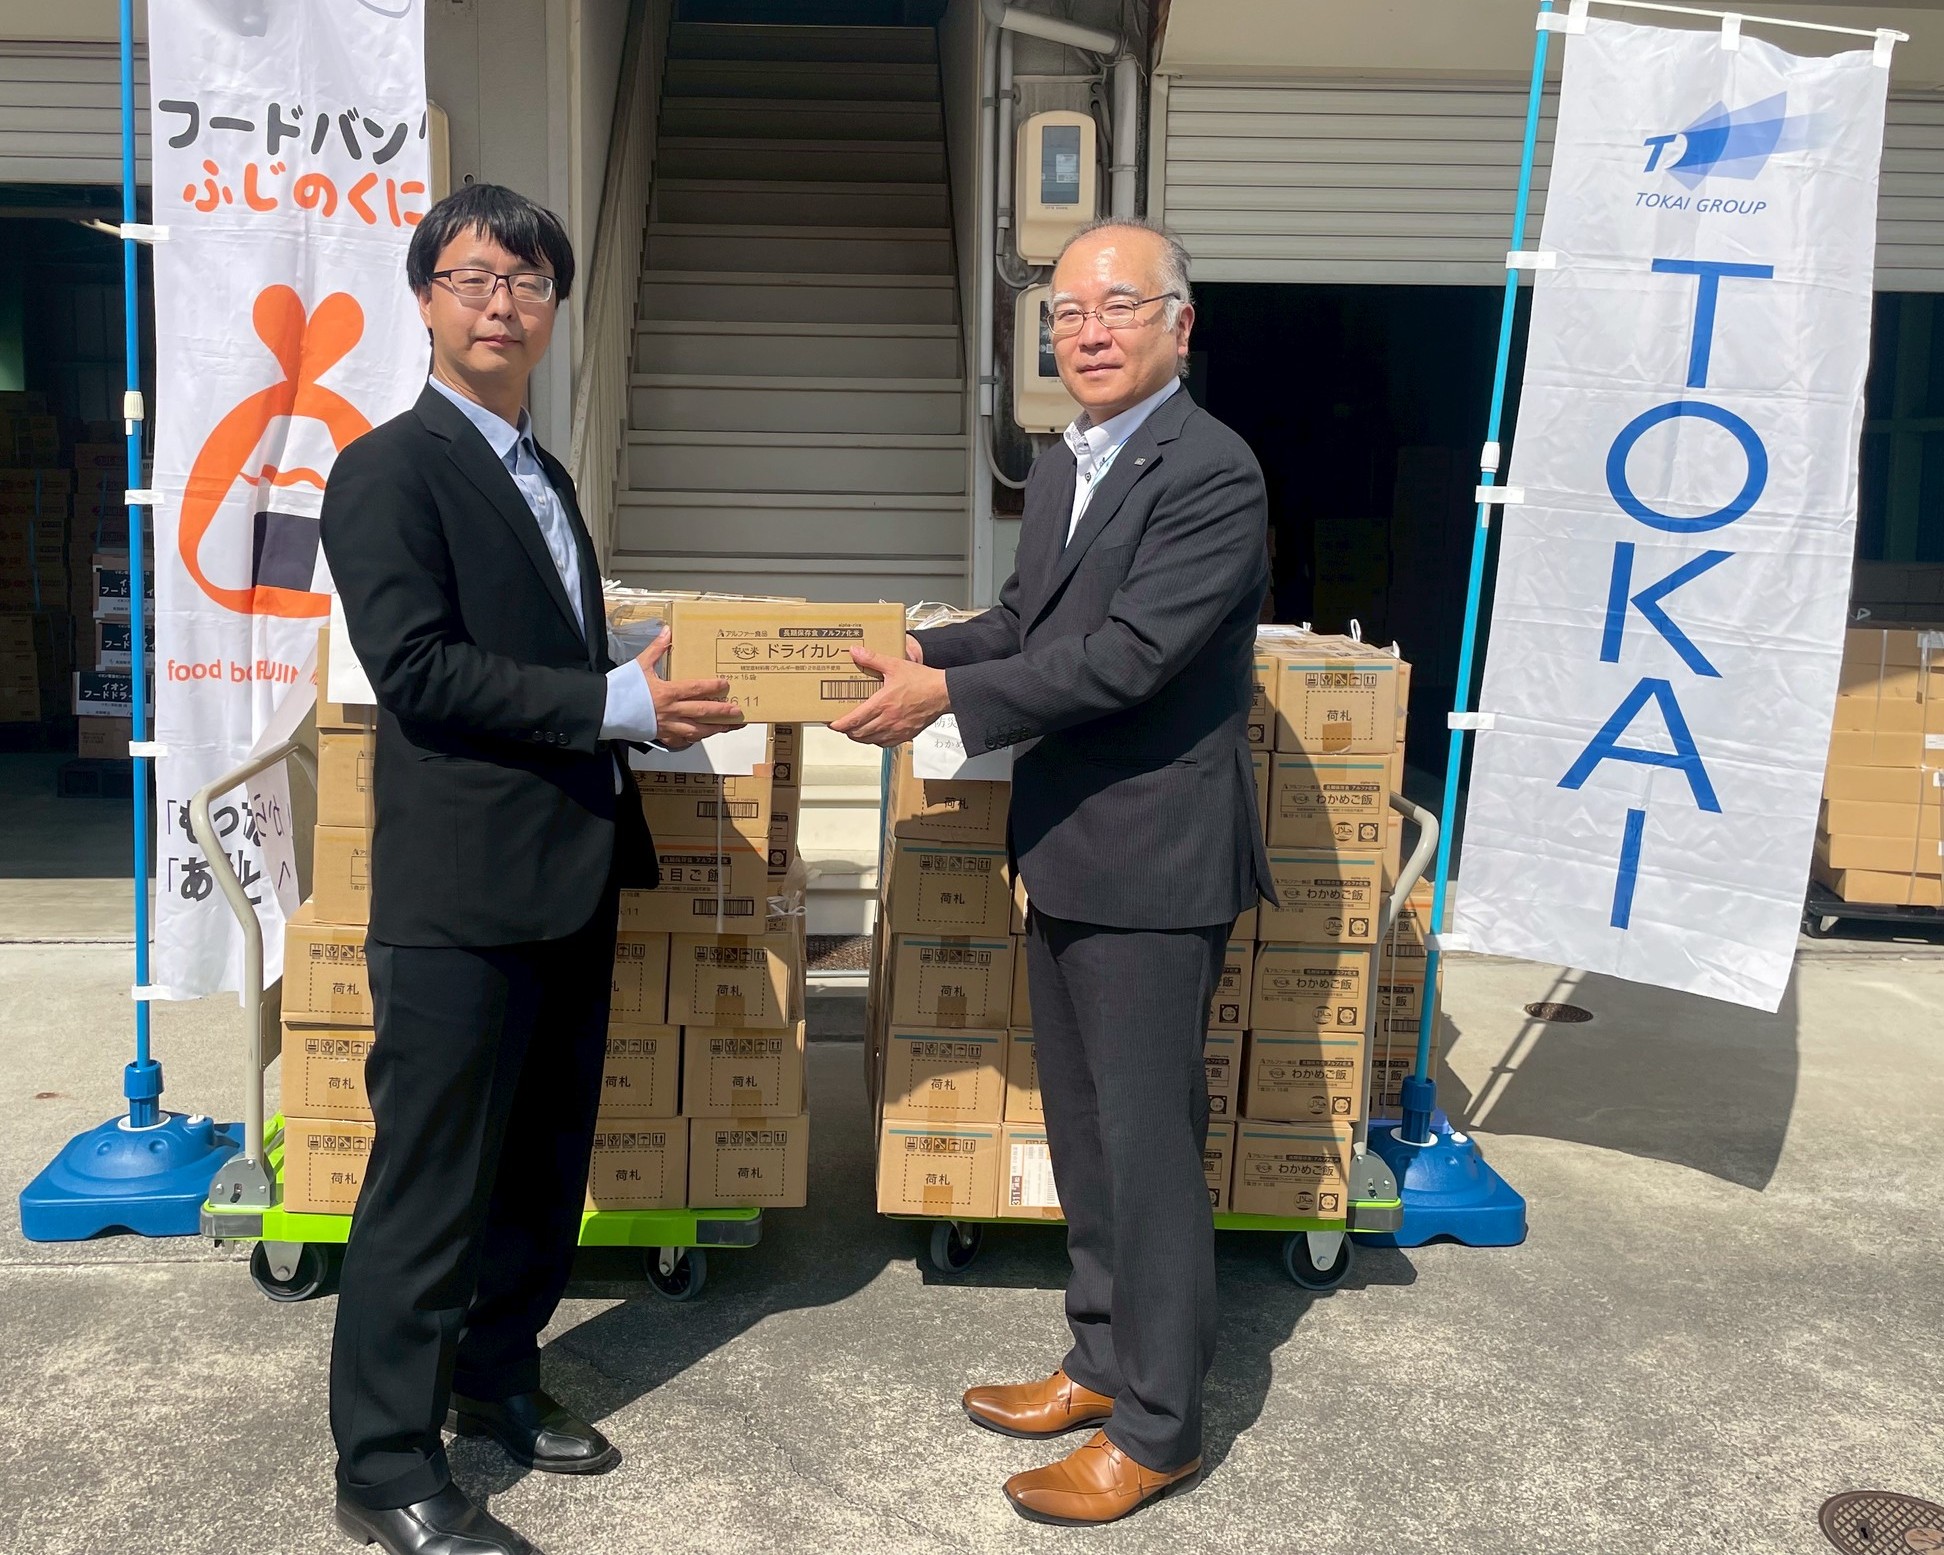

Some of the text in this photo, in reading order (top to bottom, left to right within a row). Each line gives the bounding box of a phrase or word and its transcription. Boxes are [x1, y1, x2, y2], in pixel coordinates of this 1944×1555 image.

[158, 99, 427, 165] フードバン
[183, 159, 425, 227] ふじのくに
[1635, 192, 1767, 214] TOKAI GROUP
[1557, 258, 1775, 930] TOKAI
[768, 643, 851, 659] ドライカレー
[168, 660, 222, 682] food
[102, 682, 129, 691] イオン
[1326, 709, 1352, 722] 荷札
[1316, 794, 1373, 805] わかめご飯
[940, 892, 965, 905] 荷札
[1307, 888, 1363, 901] わかめご飯
[332, 982, 360, 996] 荷札
[716, 984, 743, 997] 荷札
[1296, 978, 1352, 990] わかめご飯
[940, 985, 966, 998] 荷札
[1291, 1068, 1347, 1080] わかめご飯
[328, 1076, 355, 1090] 荷札
[605, 1075, 631, 1088] 荷札
[732, 1075, 758, 1088] 荷札
[931, 1078, 957, 1091] 荷札
[616, 1168, 642, 1181] 荷札
[737, 1167, 763, 1179] 荷札
[1278, 1164, 1334, 1176] わかめご飯
[331, 1172, 357, 1185] 荷札
[925, 1173, 951, 1186] 荷札
